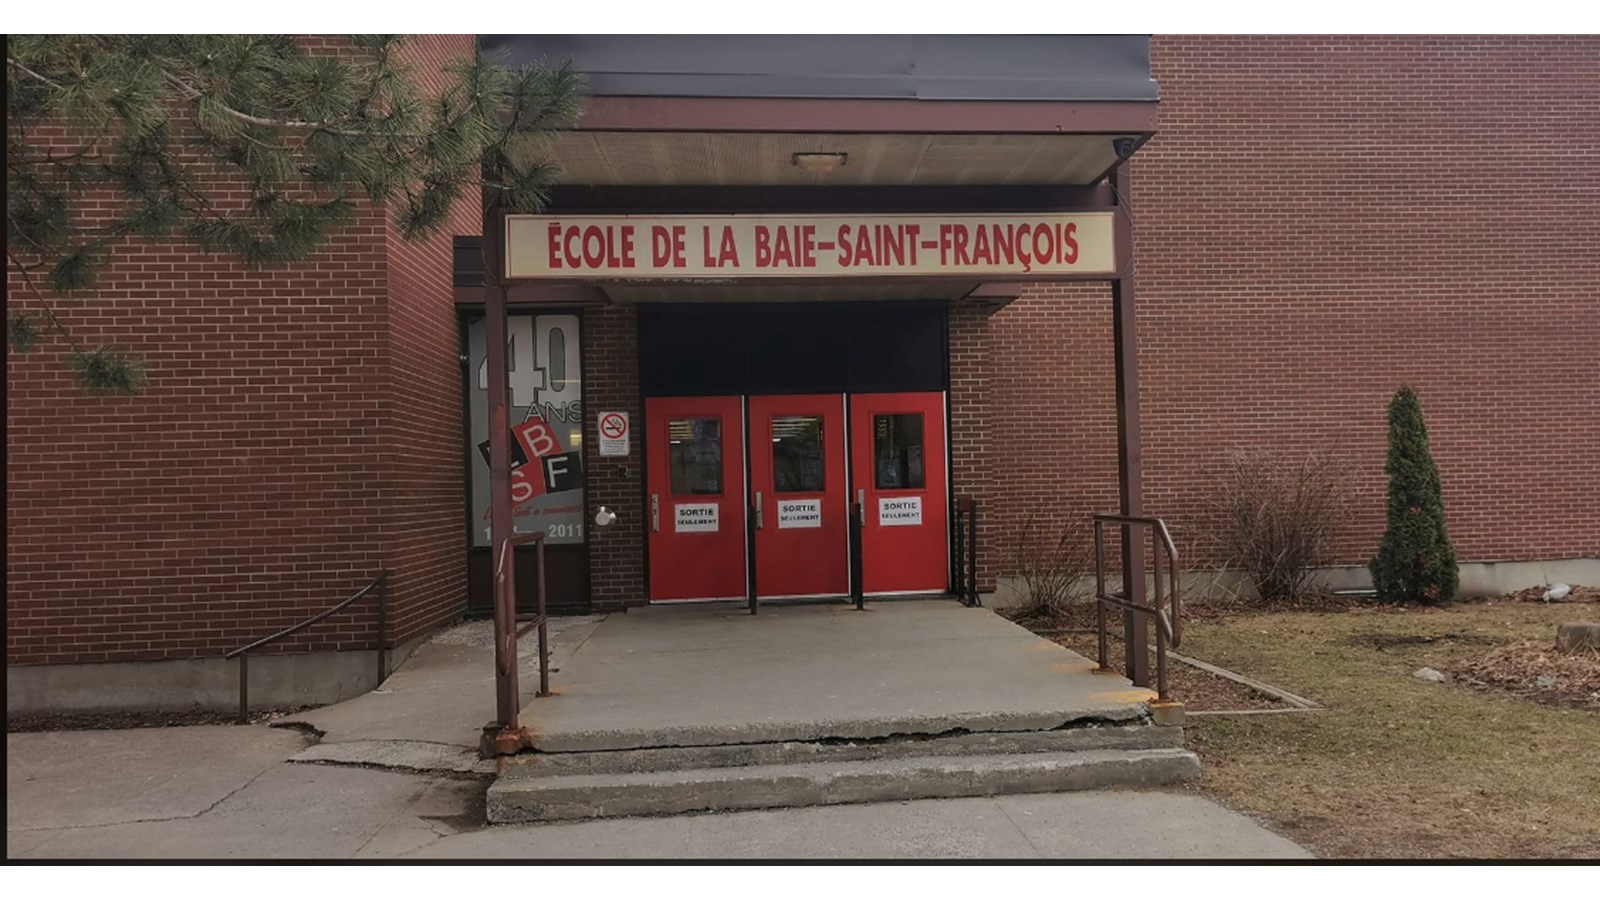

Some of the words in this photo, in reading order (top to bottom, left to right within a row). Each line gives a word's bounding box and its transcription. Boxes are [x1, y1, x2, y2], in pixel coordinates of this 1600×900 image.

[547, 221, 636, 269] ÉCOLE
[652, 225, 687, 268] DE
[703, 225, 740, 268] LA
[478, 314, 582, 408] 40
[522, 400, 582, 424] ANS
[679, 508, 714, 516] SORTIE
[782, 504, 816, 513] SORTIE
[882, 502, 917, 510] SORTIE
[549, 524, 582, 538] 2011
